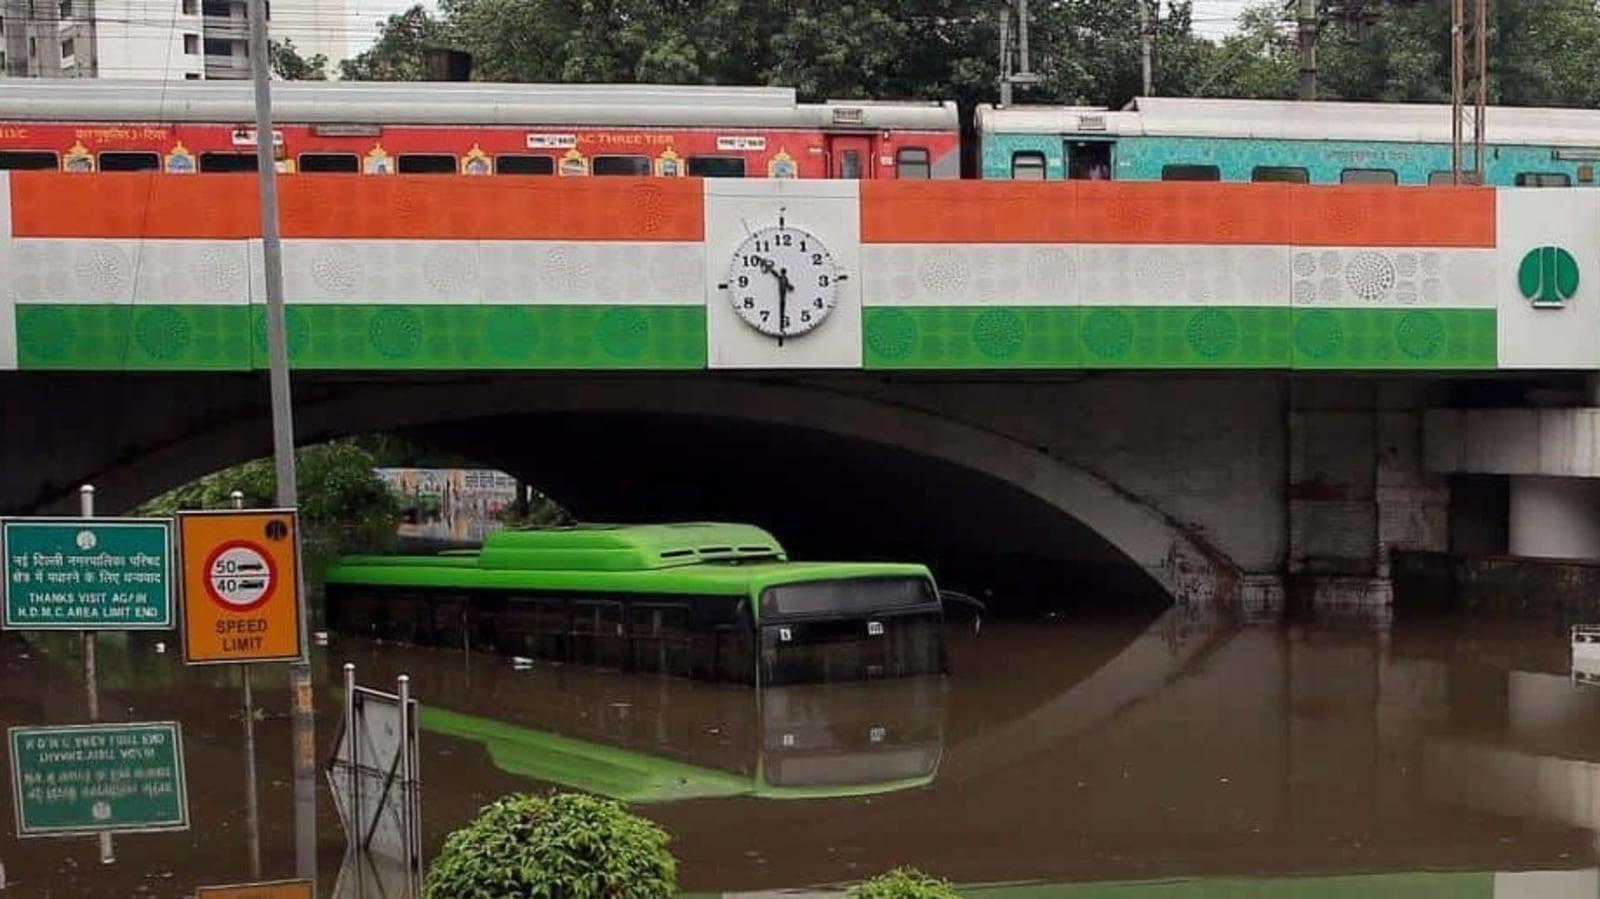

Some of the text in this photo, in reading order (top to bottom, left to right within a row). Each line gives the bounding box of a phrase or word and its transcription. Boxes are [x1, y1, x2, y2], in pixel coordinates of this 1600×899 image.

[577, 135, 594, 144] AC
[599, 135, 642, 145] THREE
[644, 135, 674, 145] TIER
[755, 240, 770, 252] 11
[775, 234, 792, 246] 12
[800, 240, 806, 252] 1
[743, 255, 760, 267] 10
[812, 253, 823, 265] 2
[738, 276, 749, 288] 9
[818, 275, 829, 287] 3
[743, 297, 754, 309] 8
[813, 297, 823, 309] 4
[759, 311, 770, 322] 7
[801, 311, 811, 322] 5
[216, 560, 236, 573] 50
[217, 580, 237, 592] 40
[29, 592, 75, 603] THANKS
[78, 592, 107, 603] VISIT
[67, 607, 99, 617] AREA
[103, 607, 130, 617] LIMIT
[135, 607, 158, 617] END
[216, 619, 268, 634] SPEED
[222, 637, 263, 651] LIMIT
